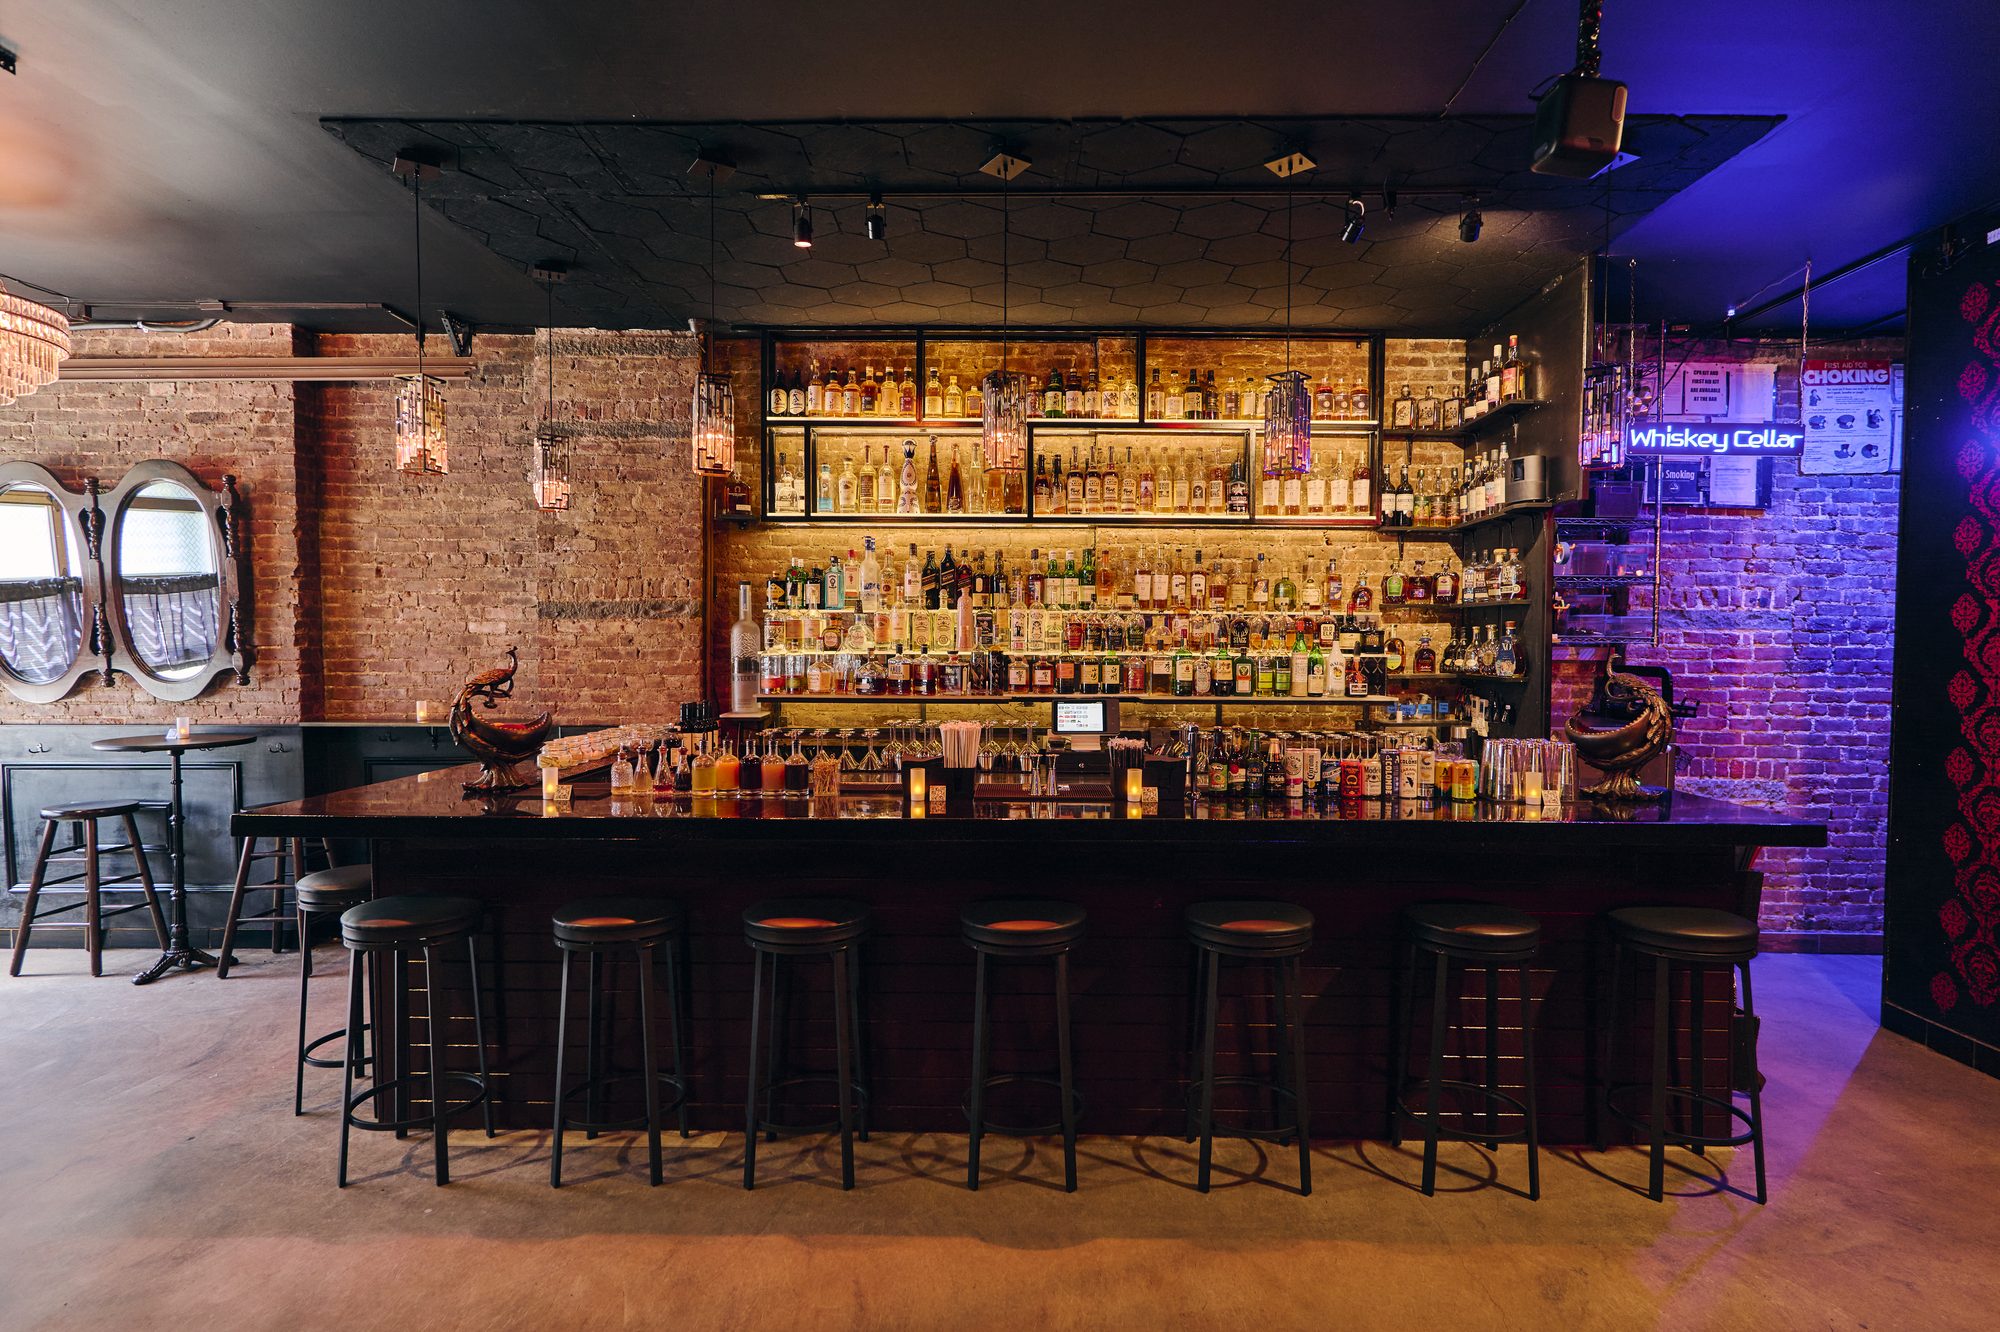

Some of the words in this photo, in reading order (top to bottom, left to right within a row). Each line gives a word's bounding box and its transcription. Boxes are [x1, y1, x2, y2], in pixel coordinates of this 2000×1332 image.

[1803, 369, 1888, 384] CHOKING
[1630, 425, 1728, 452] Whiskey
[1733, 430, 1803, 449] Cellar
[1665, 470, 1695, 480] Smoking
[1385, 761, 1393, 795] COLOMBE
